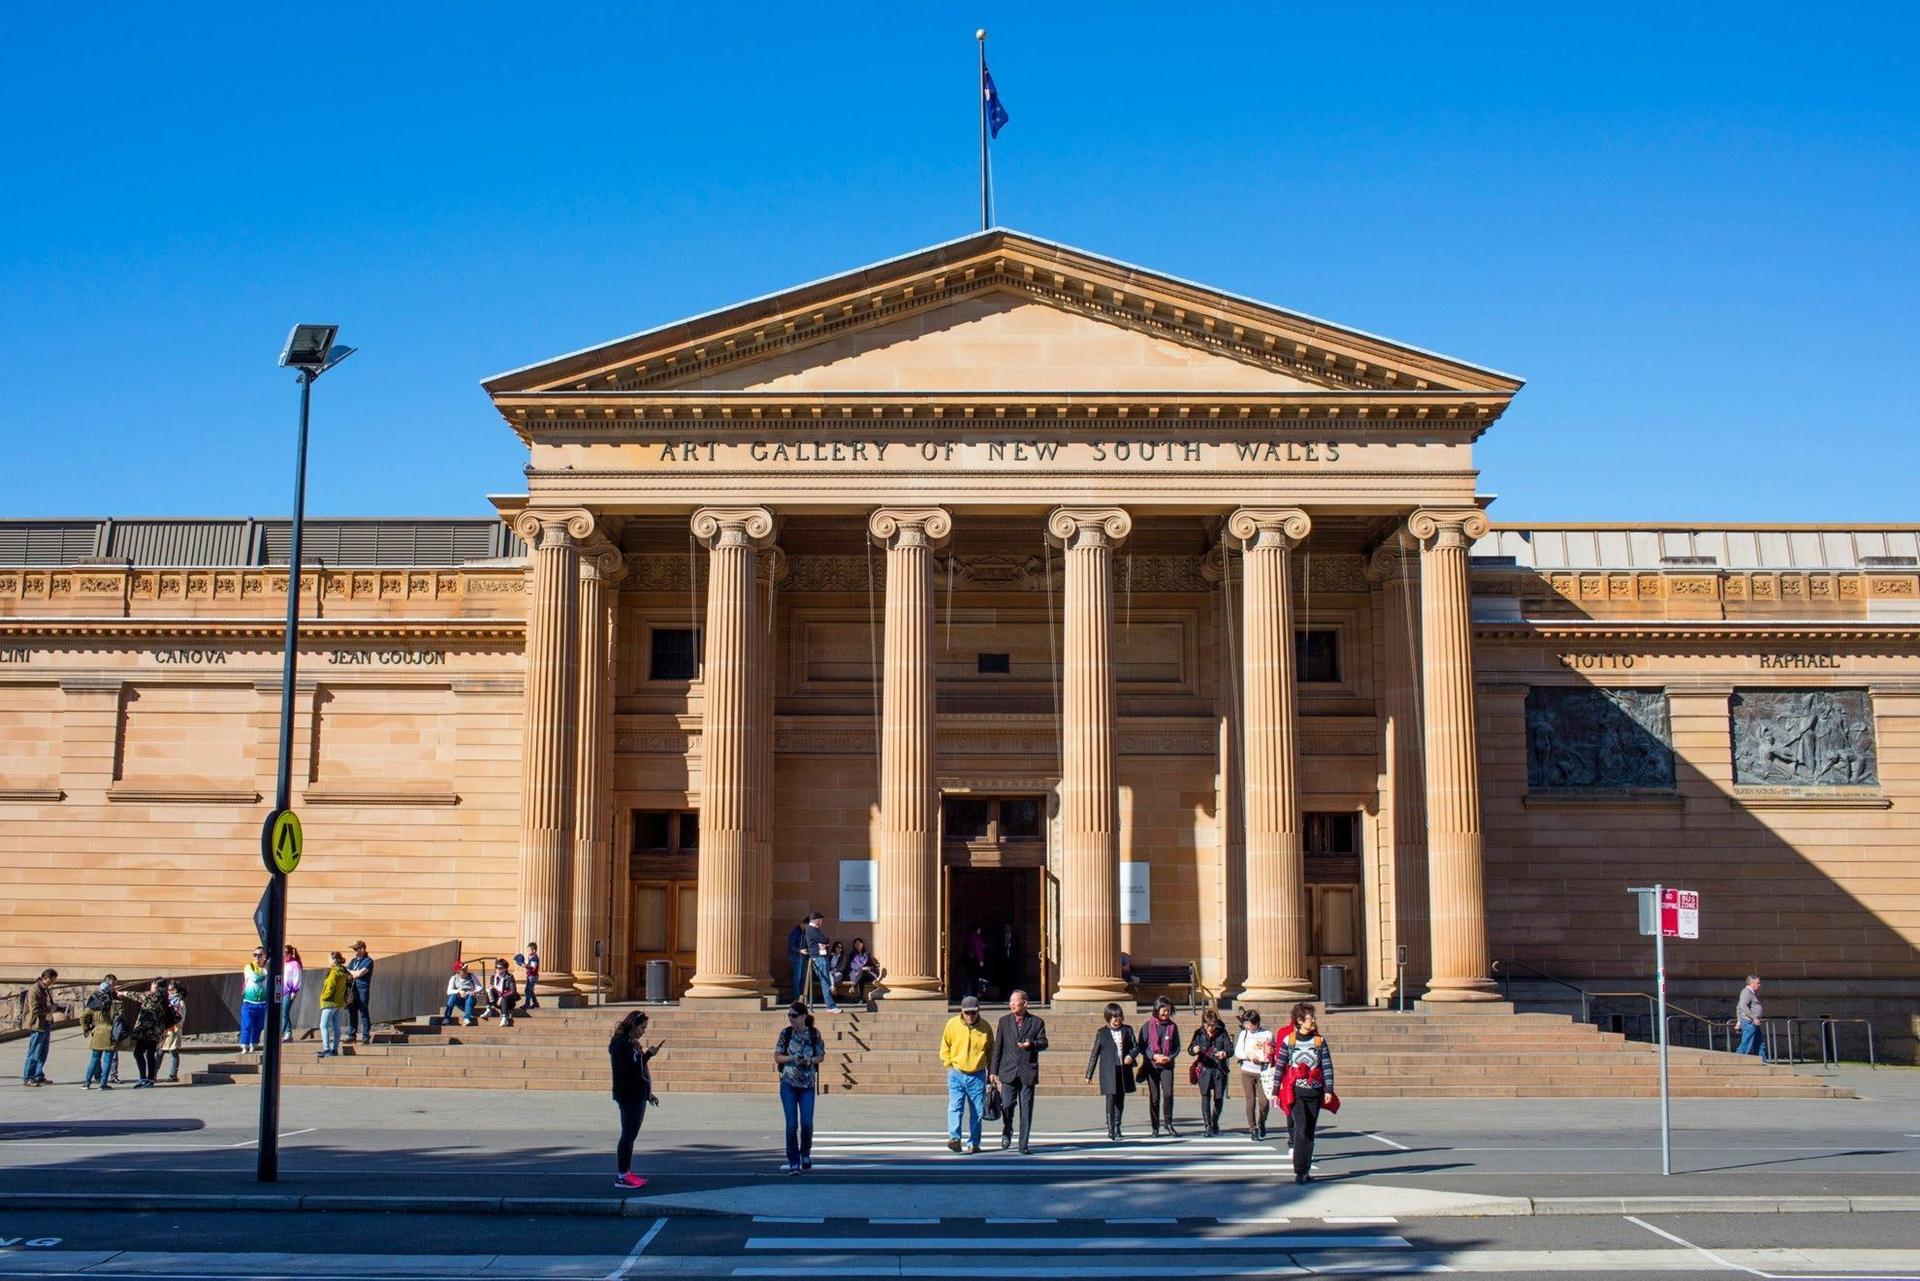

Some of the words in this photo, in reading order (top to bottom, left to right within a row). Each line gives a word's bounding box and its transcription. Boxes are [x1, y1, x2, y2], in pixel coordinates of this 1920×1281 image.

[660, 441, 719, 461] ART
[750, 441, 889, 461] GALLERY
[921, 441, 957, 461] OF
[988, 441, 1060, 461] NEW
[1093, 441, 1200, 461] SOUTH
[1234, 441, 1340, 461] WALES
[155, 650, 226, 664] CANOVA
[328, 650, 371, 664] JEAN
[379, 650, 445, 664] GOUJON
[1560, 653, 1634, 668] GIOTTO
[1760, 654, 1840, 668] RAPHAEL
